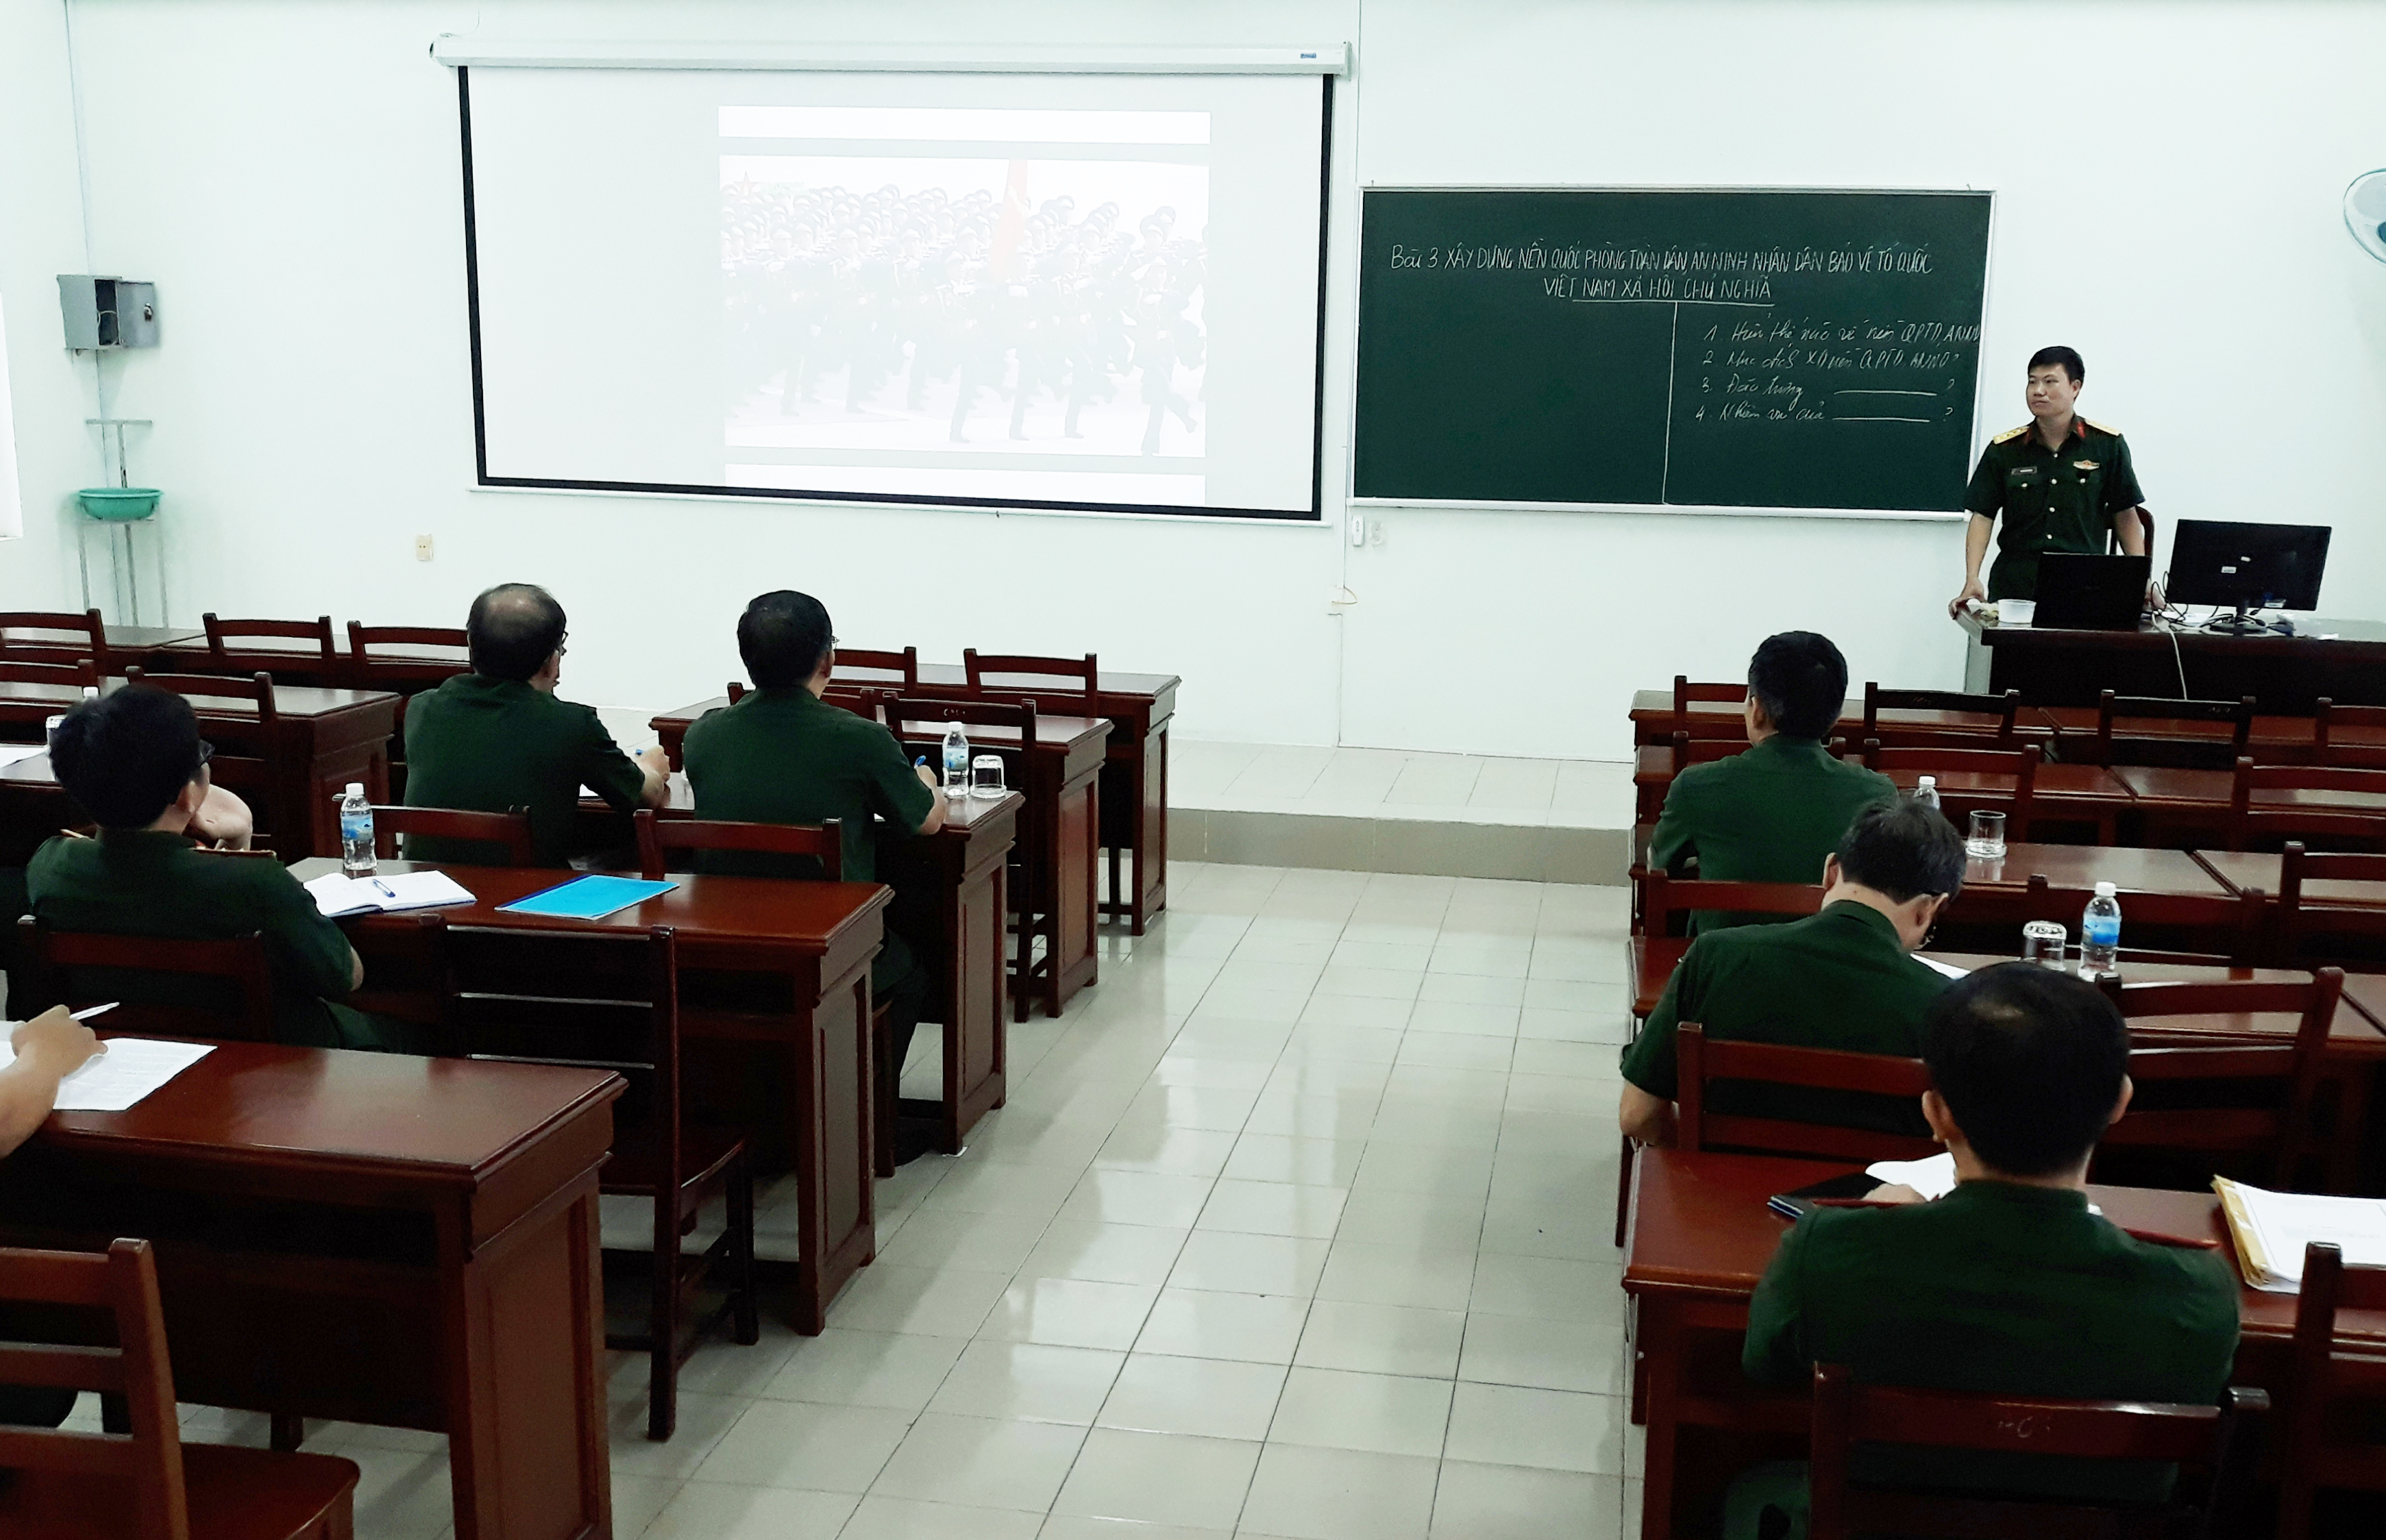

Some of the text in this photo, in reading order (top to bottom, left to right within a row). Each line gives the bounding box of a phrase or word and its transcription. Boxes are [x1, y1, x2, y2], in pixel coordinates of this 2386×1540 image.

[1427, 247, 1438, 269] 3
[1444, 241, 1474, 269] XÂY
[1518, 238, 1547, 269] NỀN
[1551, 240, 1582, 270] QUỐC
[1584, 241, 1626, 270] PHÒNG
[1629, 243, 1660, 271] TOÀN
[1690, 251, 1710, 271] AN
[1710, 251, 1748, 271] NINH
[1752, 245, 1791, 273] NHÂN
[1794, 246, 1824, 272] DÂN
[1897, 243, 1932, 274] QUỐC
[1582, 277, 1616, 299] NAM
